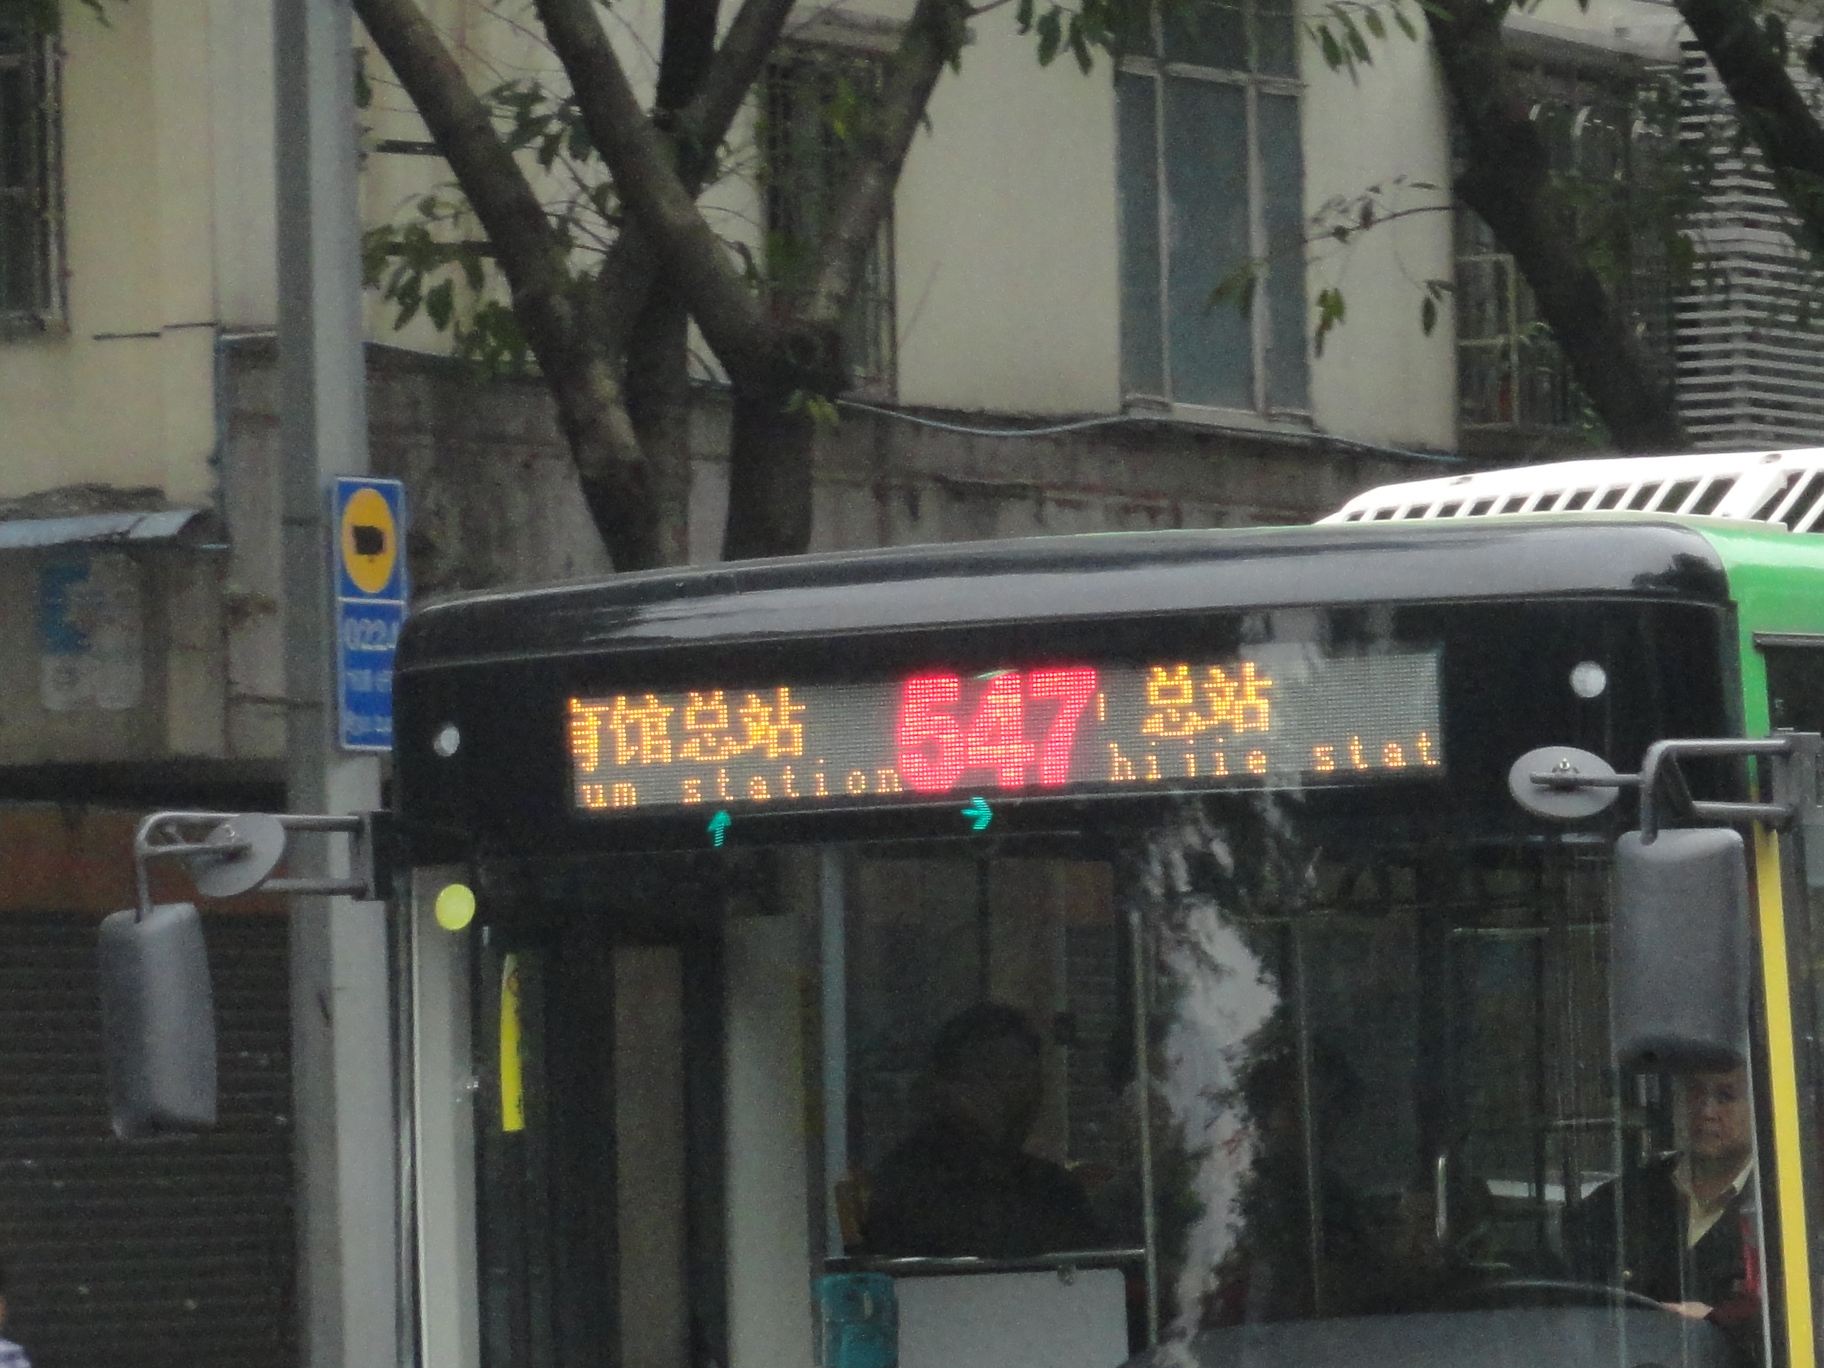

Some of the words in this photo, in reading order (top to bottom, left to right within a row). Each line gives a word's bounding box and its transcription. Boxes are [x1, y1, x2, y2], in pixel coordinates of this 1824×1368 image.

[1142, 661, 1273, 733] 总站
[899, 667, 1099, 793] 547
[1312, 731, 1442, 772] stat
[582, 781, 639, 808] um
[683, 757, 904, 804] station
